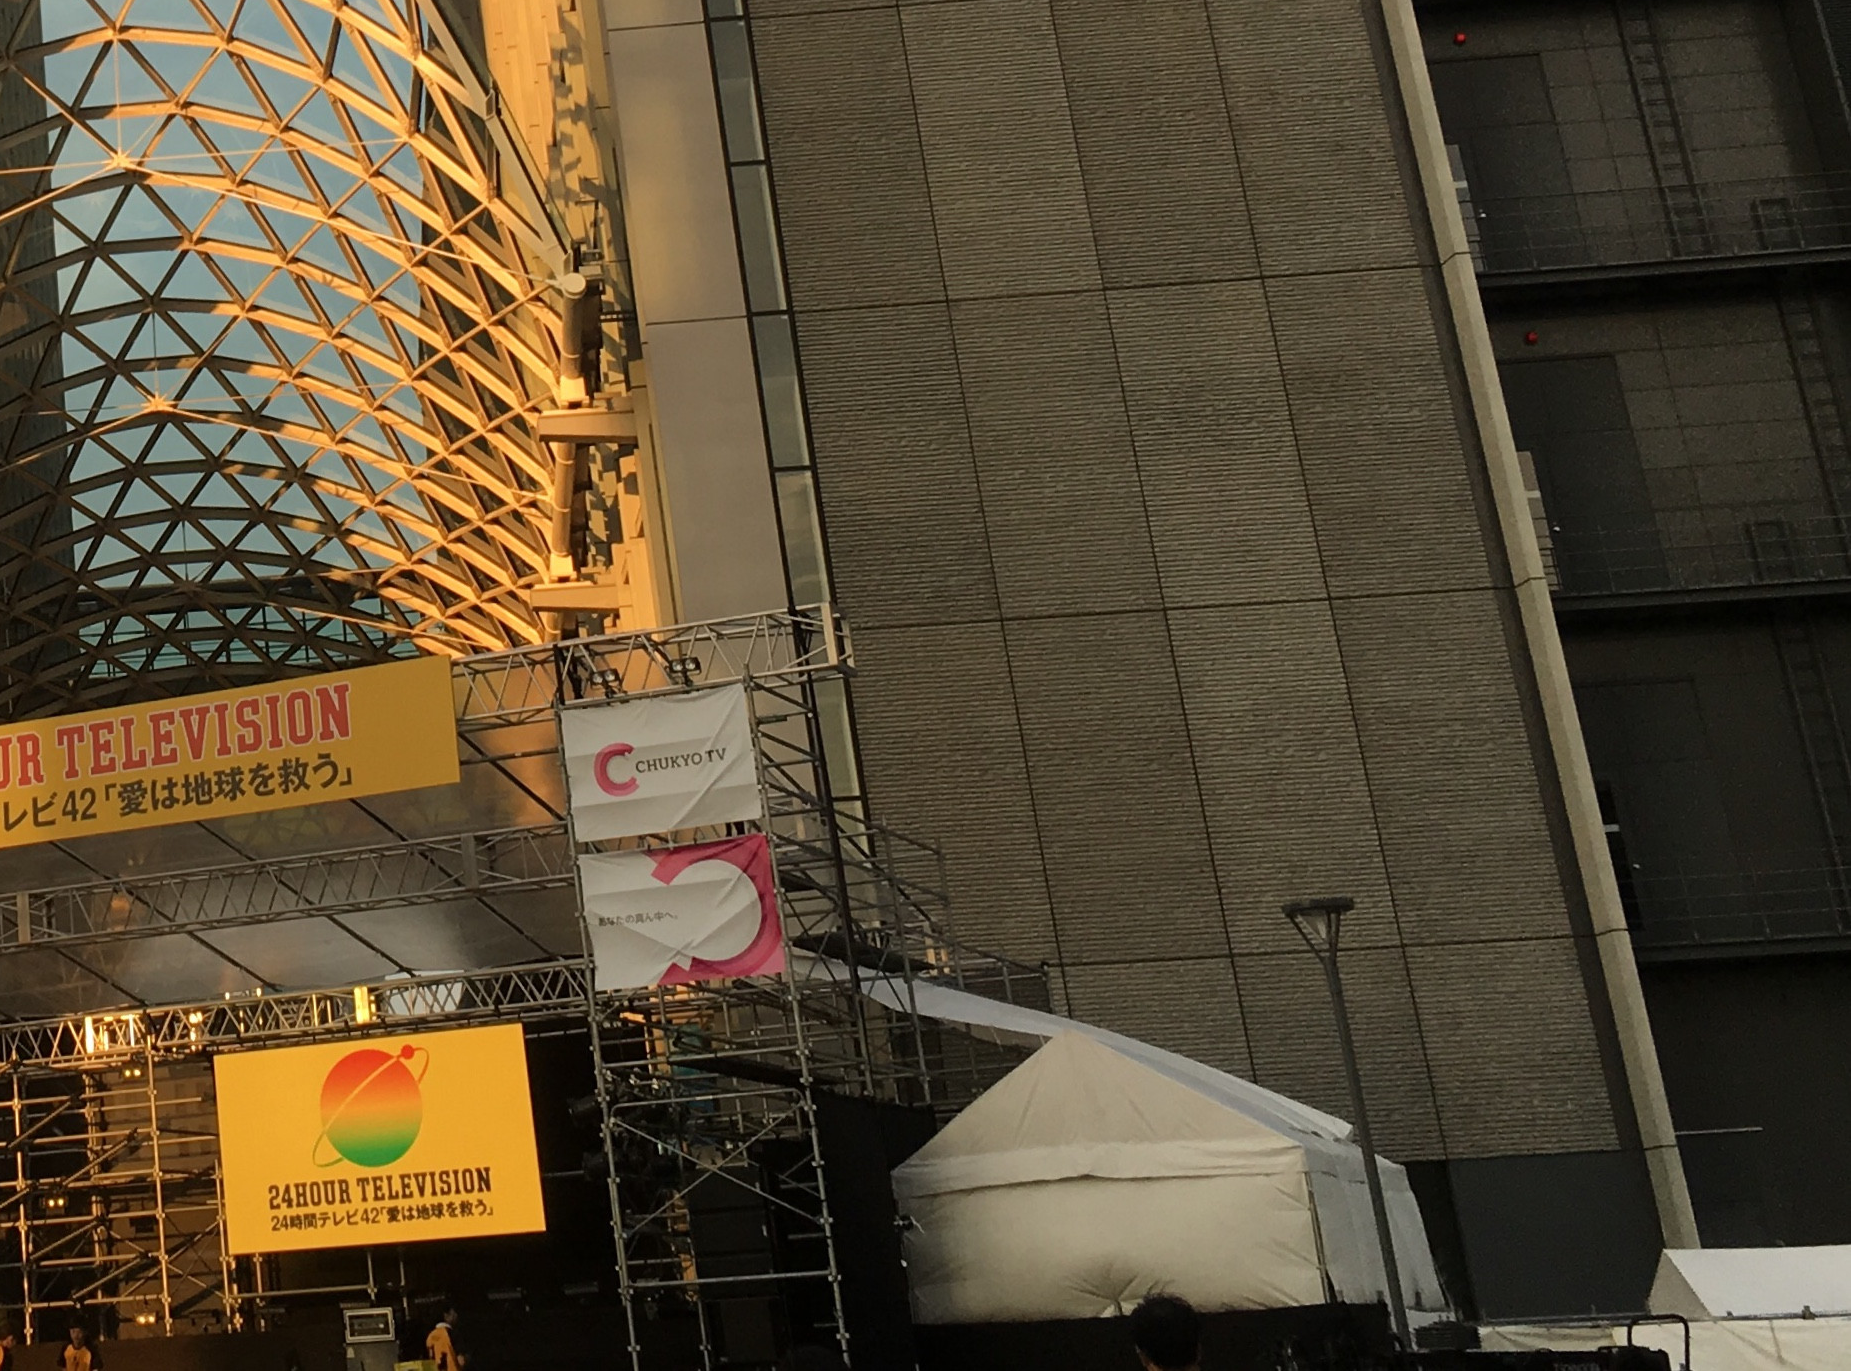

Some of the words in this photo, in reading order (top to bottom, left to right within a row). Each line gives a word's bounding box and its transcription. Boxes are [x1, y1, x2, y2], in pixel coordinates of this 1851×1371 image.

[56, 682, 352, 780] TELEVISION
[635, 751, 703, 774] CHUKYO
[705, 747, 727, 763] TV
[268, 1179, 352, 1210] 24HOUR
[356, 1167, 492, 1202] TELEVISION
[271, 1198, 494, 1232] 24時間テレビ42「愛は地球を救う」
